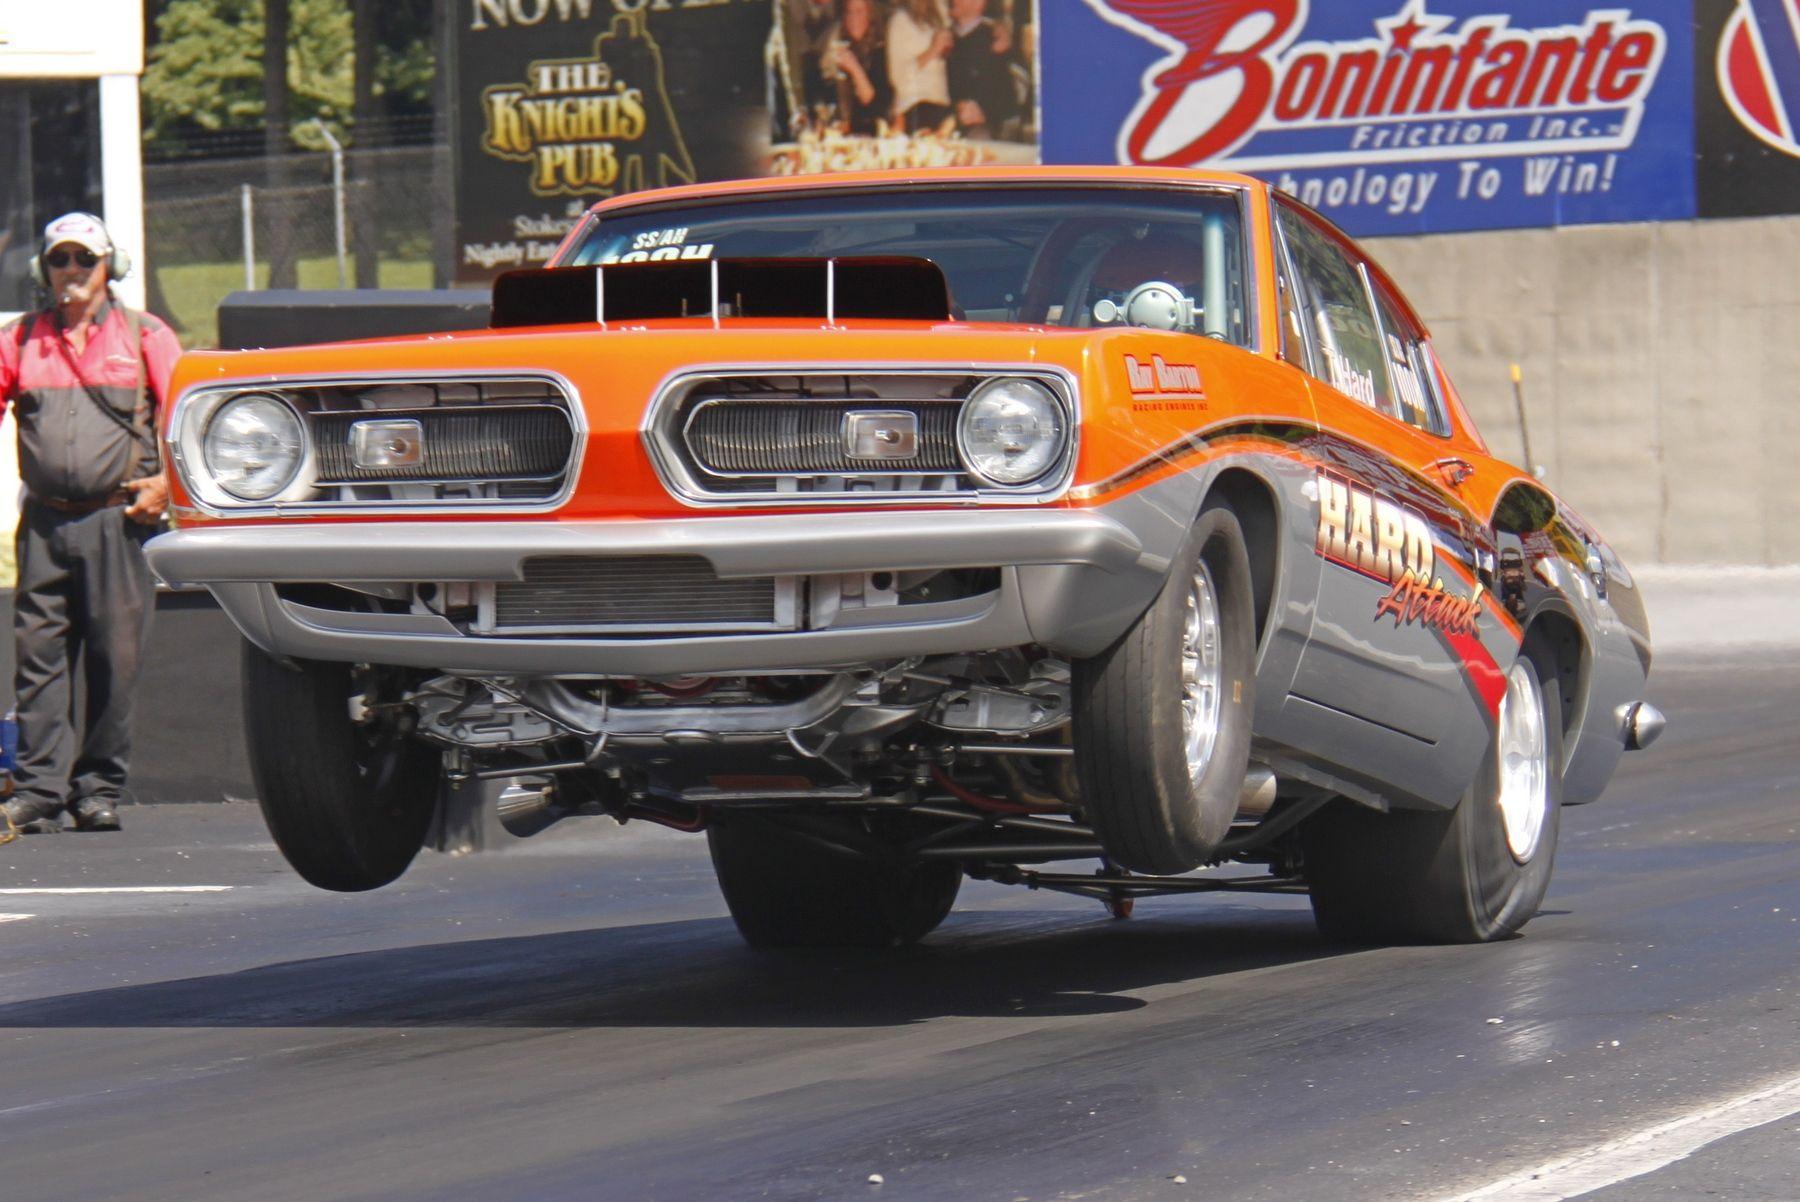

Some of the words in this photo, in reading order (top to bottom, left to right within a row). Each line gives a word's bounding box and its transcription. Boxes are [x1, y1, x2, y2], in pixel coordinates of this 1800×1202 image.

[538, 64, 609, 92] THE
[1126, 0, 1656, 166] Boninfante
[488, 80, 646, 151] KNIGHT'S
[1351, 124, 1508, 150] Friction
[1528, 116, 1600, 140] Inc.
[537, 141, 619, 187] PUB
[1279, 170, 1438, 215] hnology
[1458, 161, 1501, 199] To
[1524, 154, 1617, 196] Win!
[633, 228, 689, 249] SS/AH
[1316, 474, 1435, 588] HARD
[1372, 566, 1484, 640] Attack
